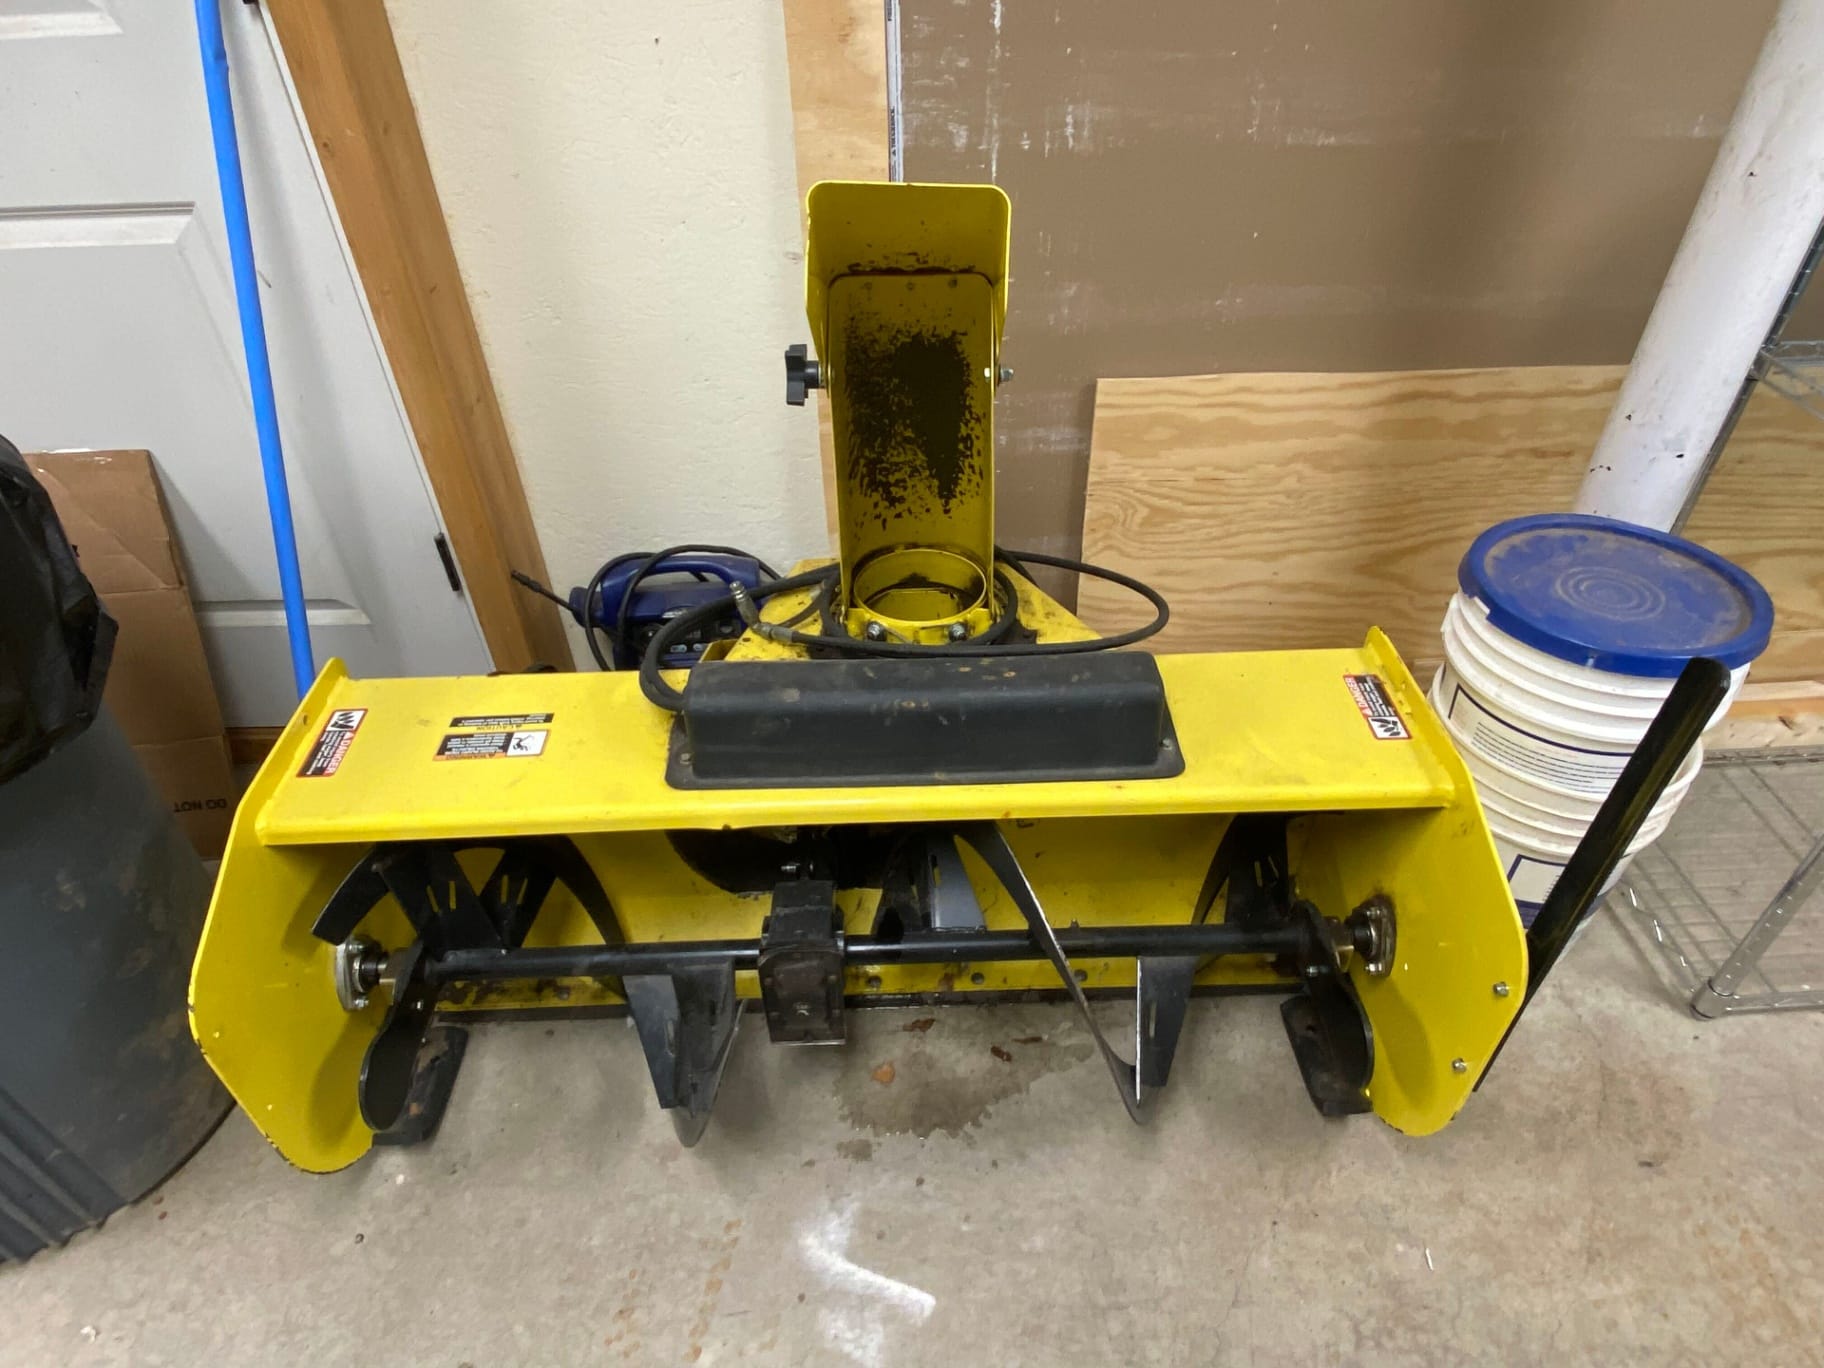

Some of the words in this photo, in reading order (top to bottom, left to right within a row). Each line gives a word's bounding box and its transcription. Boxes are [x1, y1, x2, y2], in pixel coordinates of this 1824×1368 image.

[326, 739, 350, 773] DANGER
[174, 800, 202, 812] NOT
[206, 798, 227, 809] DO
